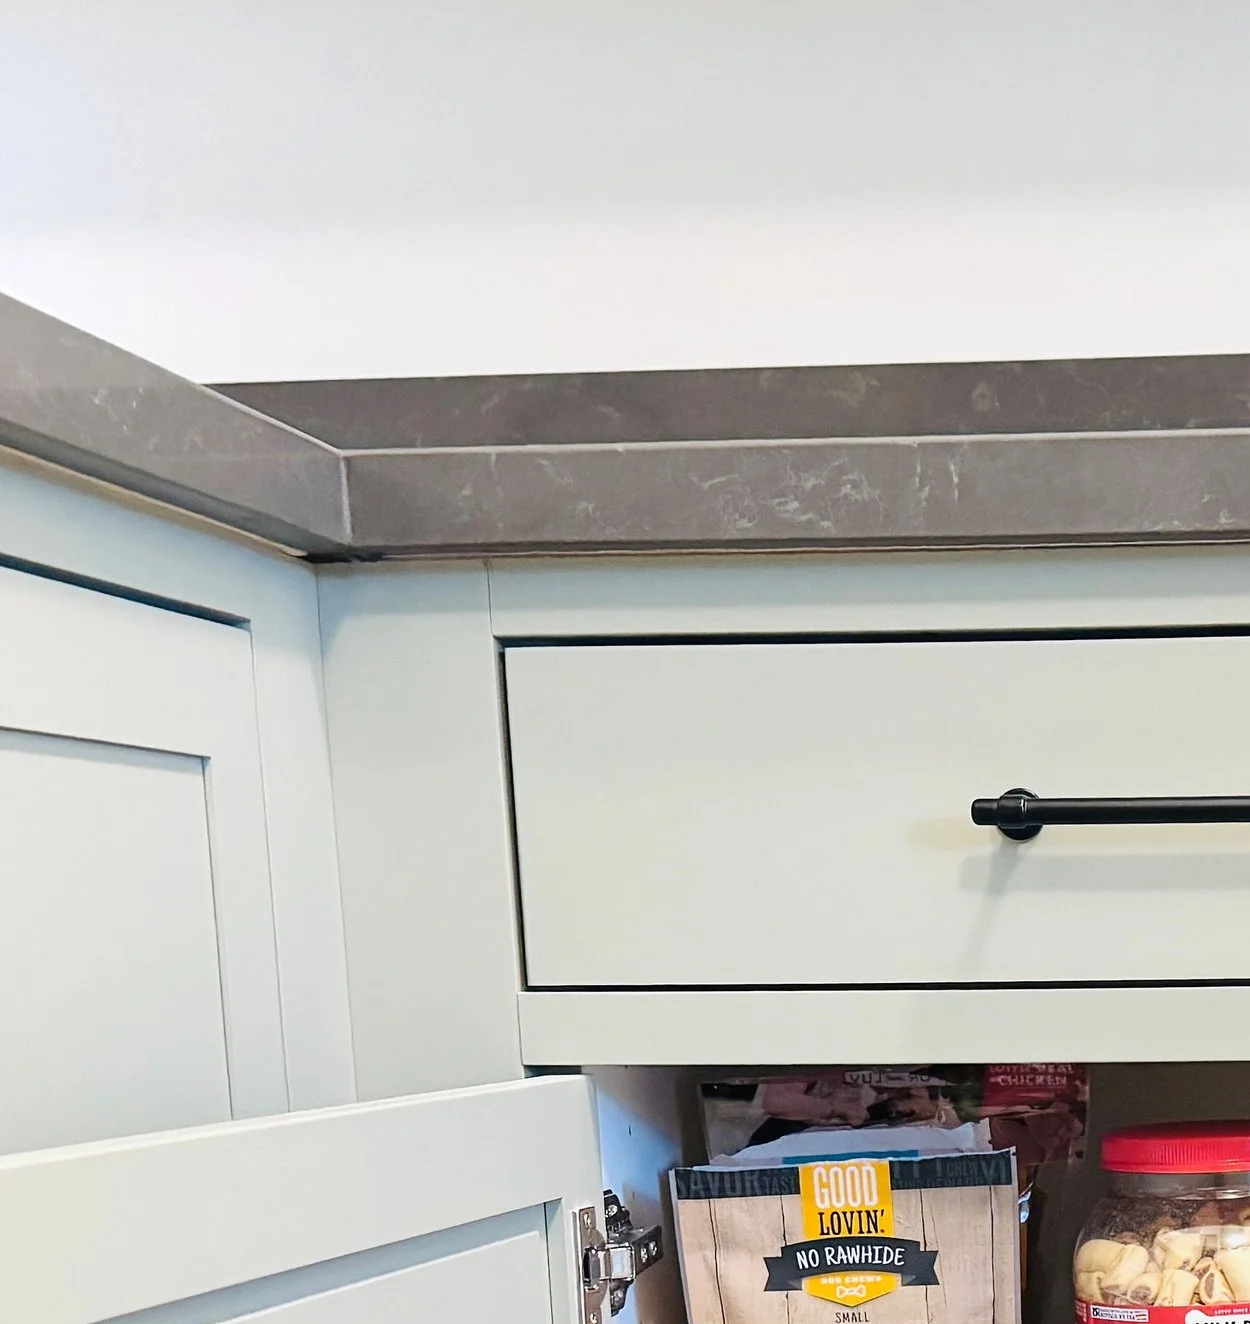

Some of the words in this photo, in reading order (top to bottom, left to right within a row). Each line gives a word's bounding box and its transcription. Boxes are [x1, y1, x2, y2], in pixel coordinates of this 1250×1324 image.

[999, 1074, 1068, 1086] CHICKEN
[813, 1165, 879, 1209] GOOD
[796, 1248, 820, 1270] NO
[824, 1244, 905, 1266] RAWHIDE
[835, 1311, 870, 1323] SMALL
